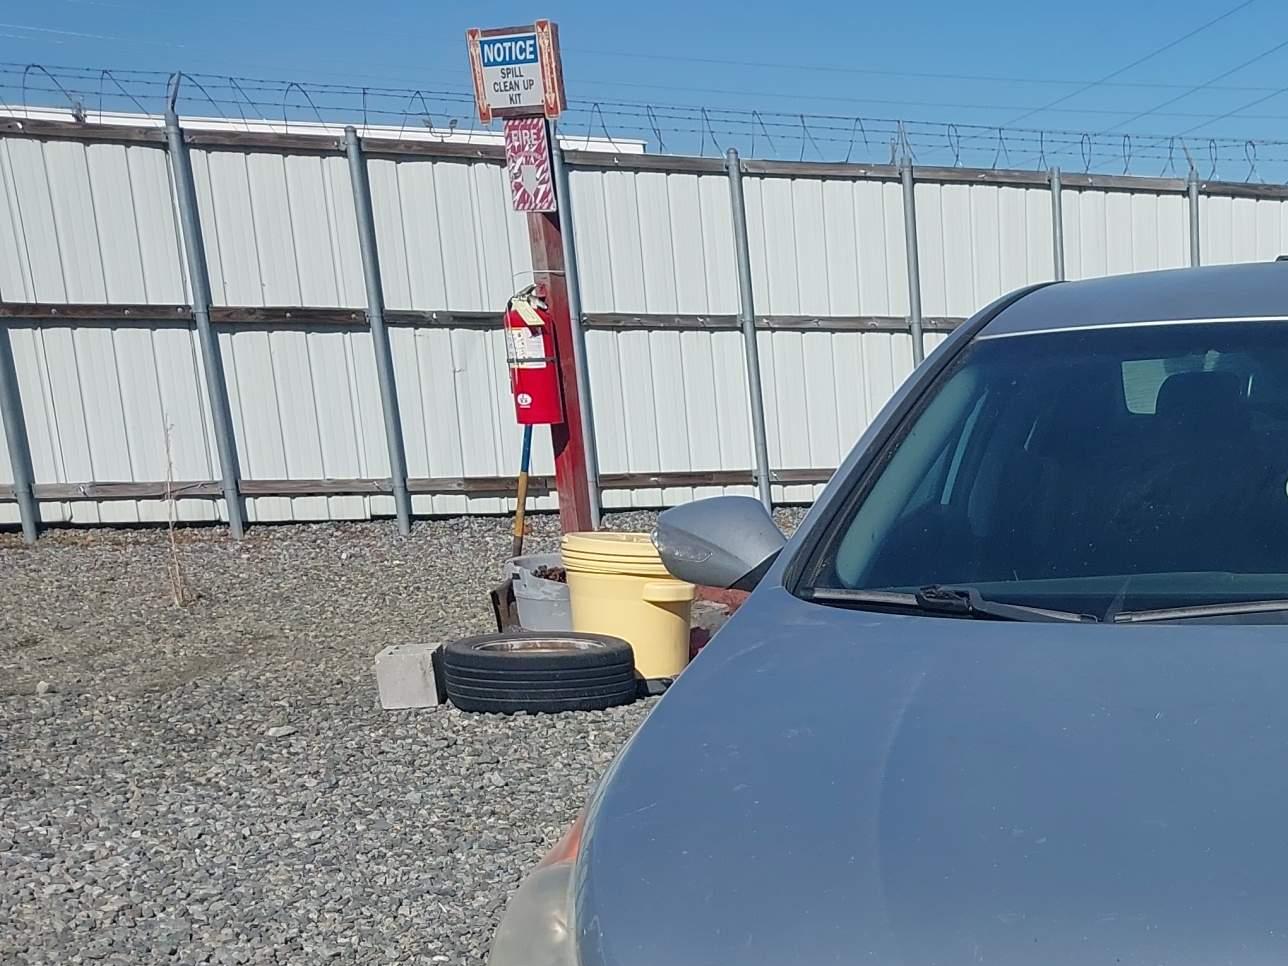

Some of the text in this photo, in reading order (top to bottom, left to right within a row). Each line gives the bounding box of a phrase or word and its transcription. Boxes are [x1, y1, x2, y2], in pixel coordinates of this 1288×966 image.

[483, 39, 535, 63] NOTICE
[500, 67, 524, 79] SPILL
[493, 79, 535, 93] CLEAN UP
[509, 93, 522, 105] KIT
[511, 129, 539, 145] FIRE
